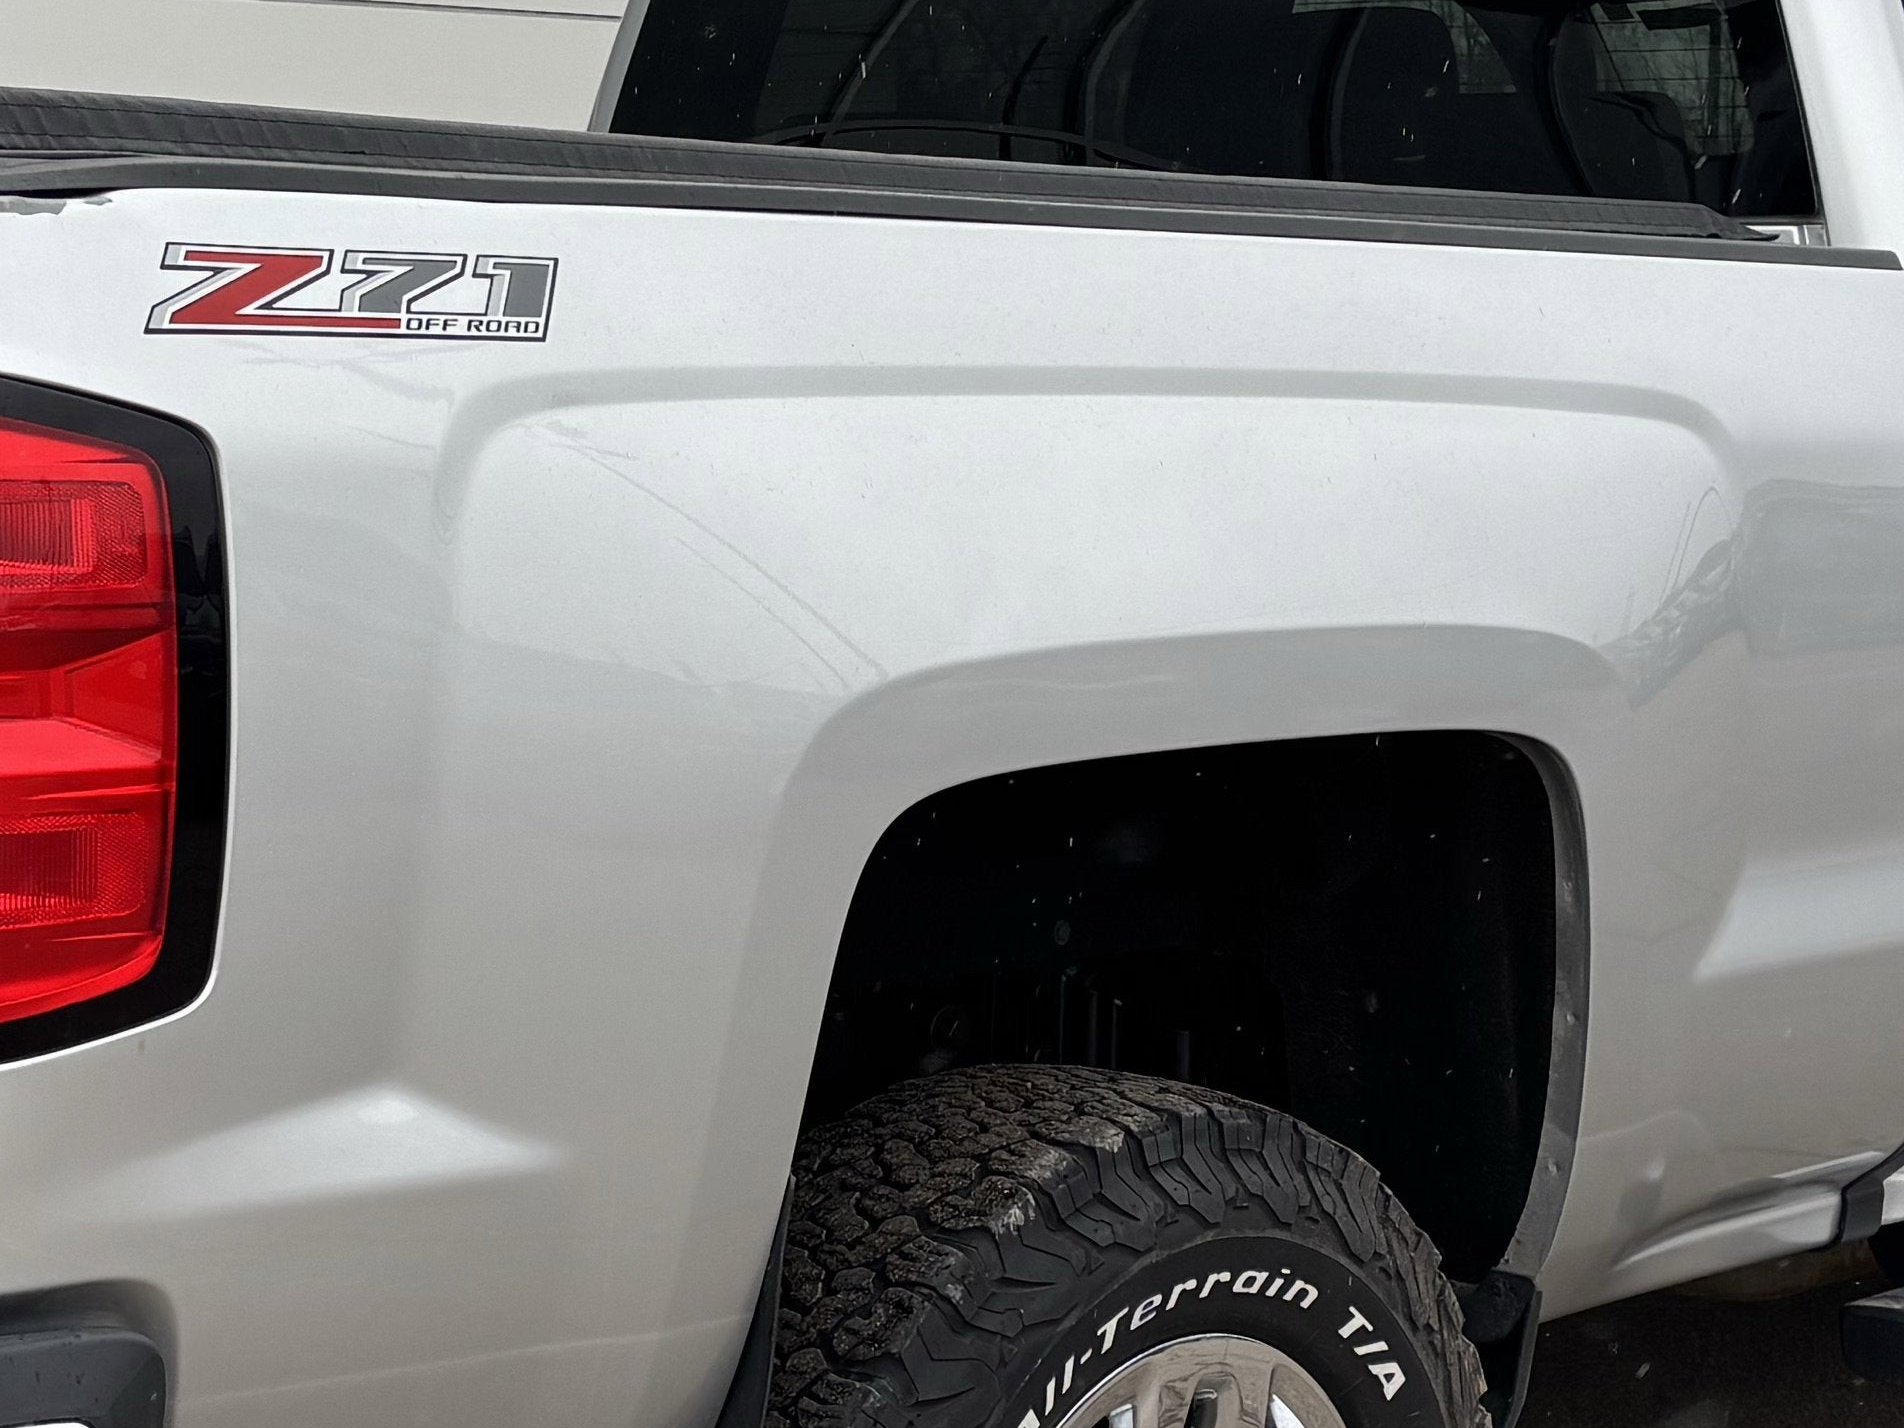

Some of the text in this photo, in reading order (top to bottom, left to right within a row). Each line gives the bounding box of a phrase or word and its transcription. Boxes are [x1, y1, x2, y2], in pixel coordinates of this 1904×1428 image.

[143, 241, 560, 342] Z71
[405, 316, 541, 335] OFF ROAD
[1337, 1305, 1407, 1402] T/A
